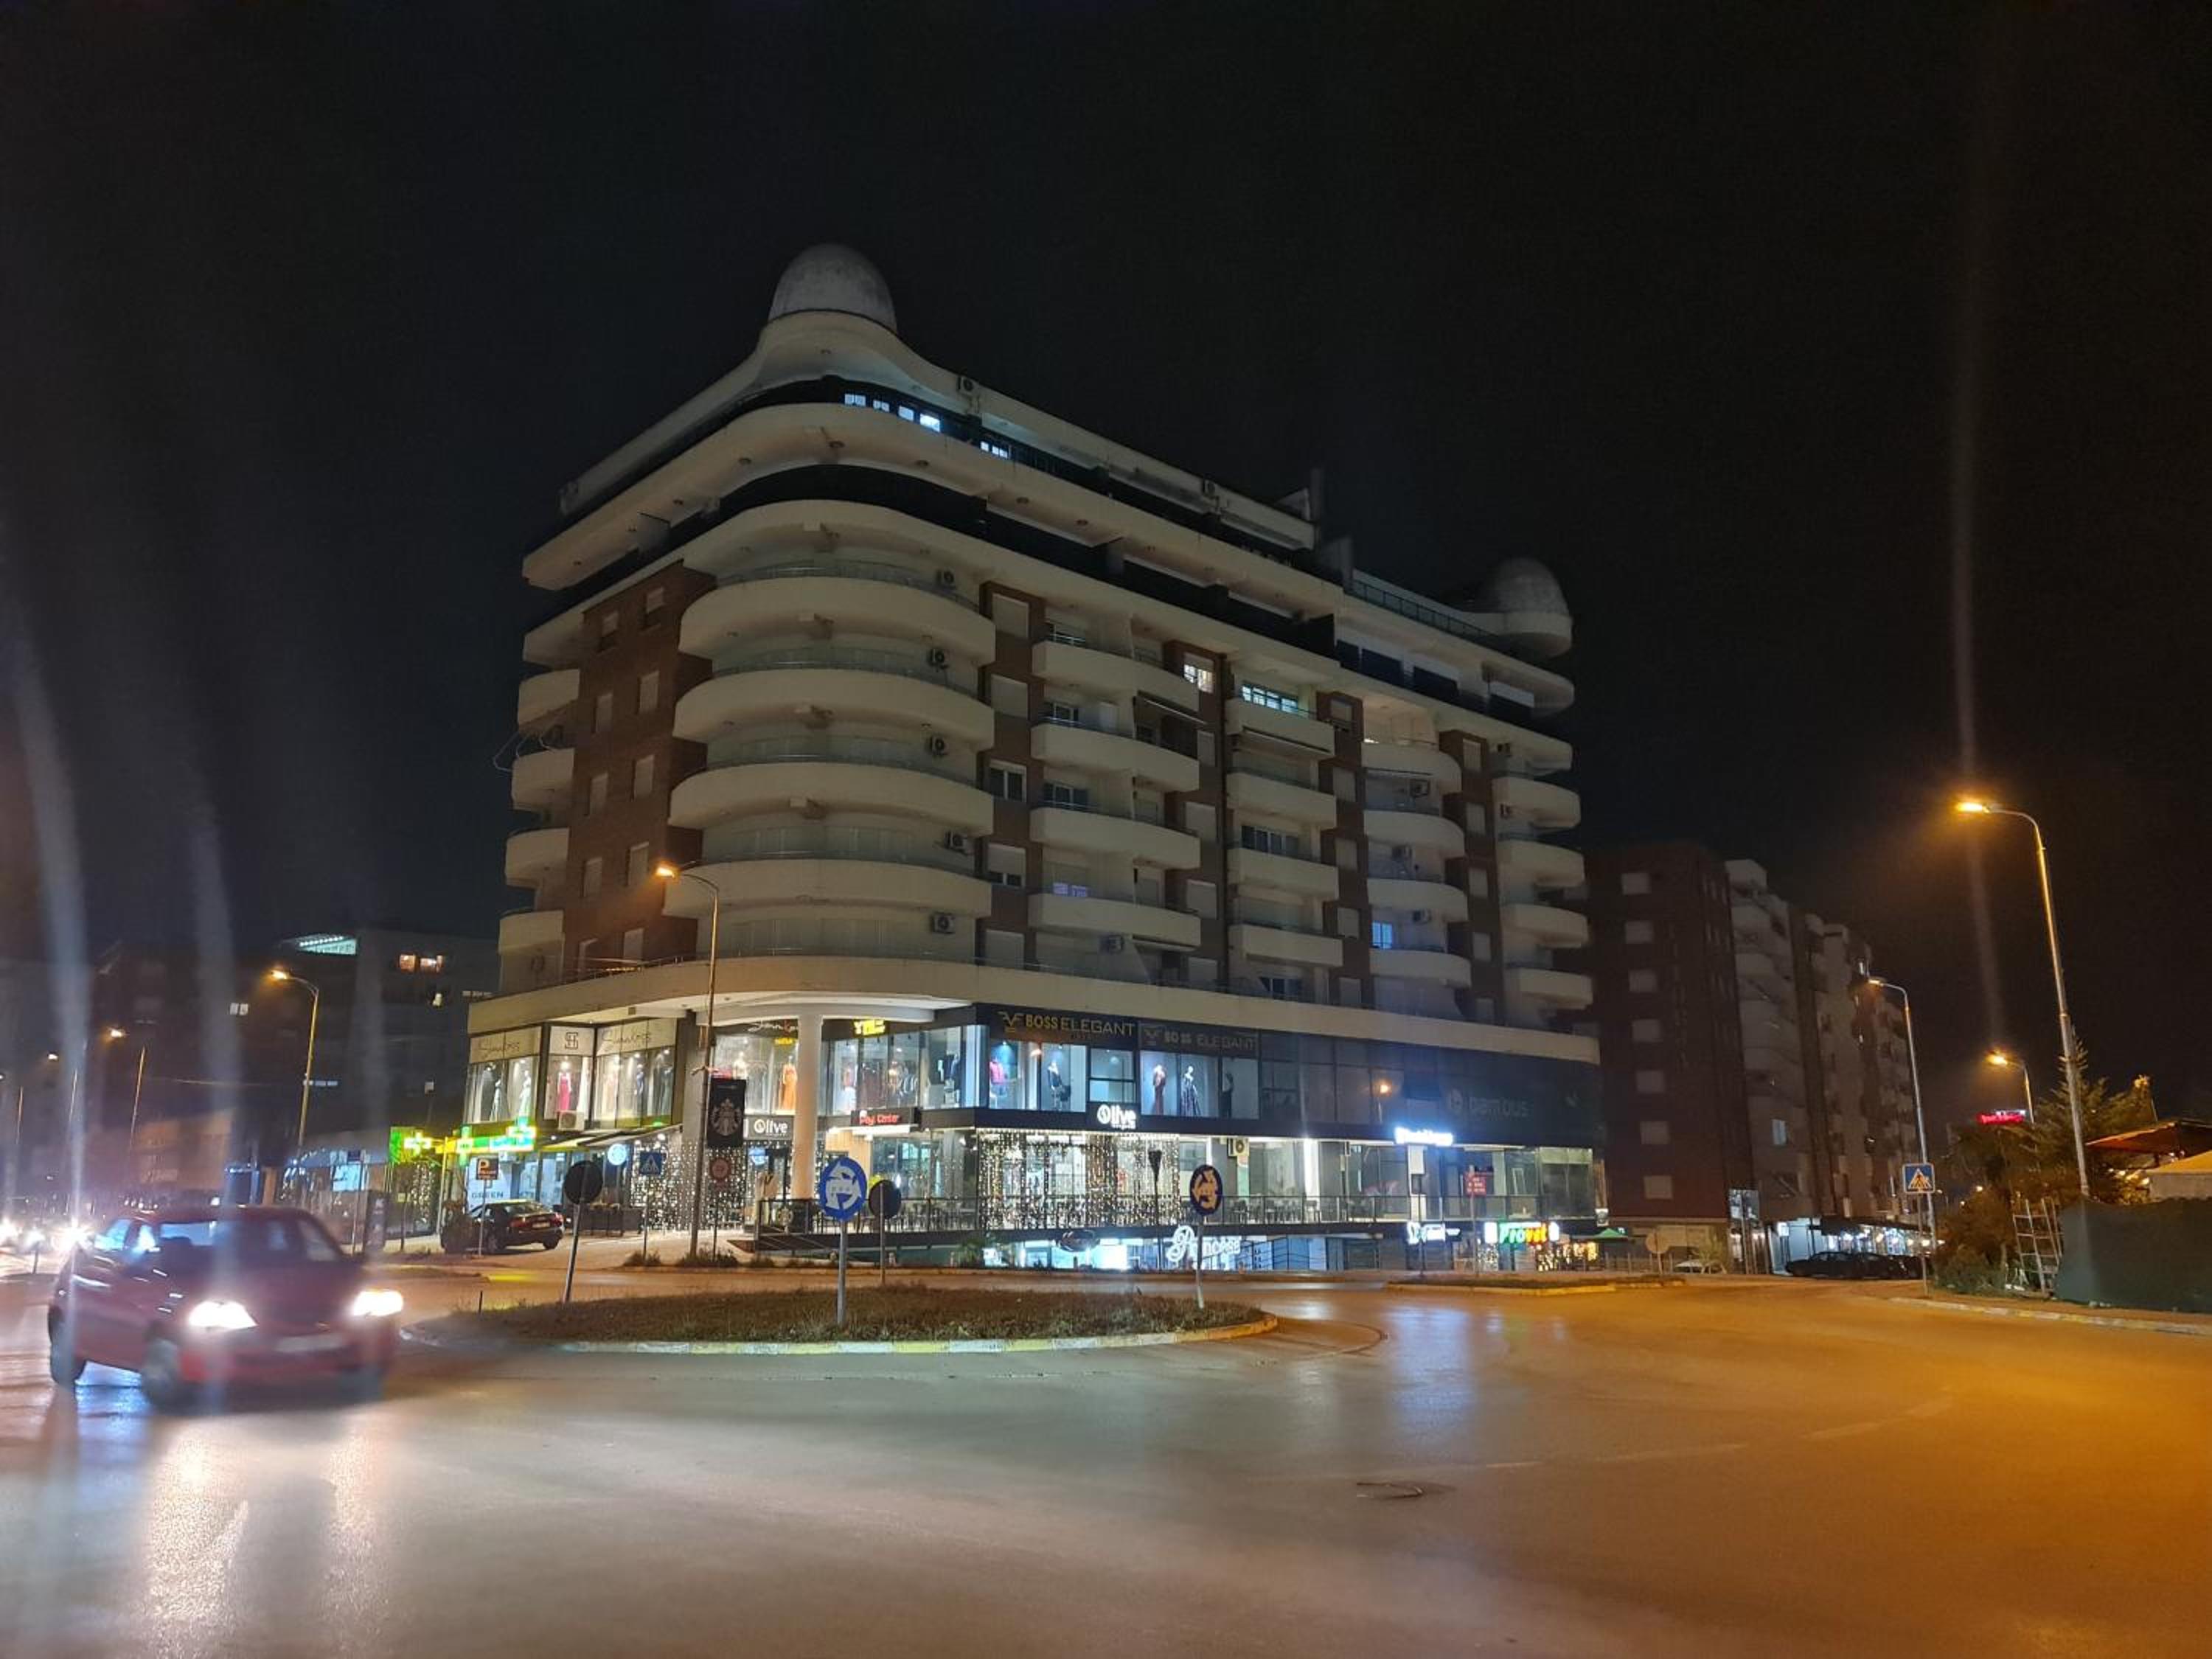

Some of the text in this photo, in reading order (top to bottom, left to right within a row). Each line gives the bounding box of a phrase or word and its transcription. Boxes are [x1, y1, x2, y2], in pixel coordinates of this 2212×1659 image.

[1026, 1014, 1135, 1035] BOSS ELEGANT
[1097, 1104, 1136, 1125] Olive
[754, 1119, 788, 1133] Olive
[478, 1159, 490, 1171] P
